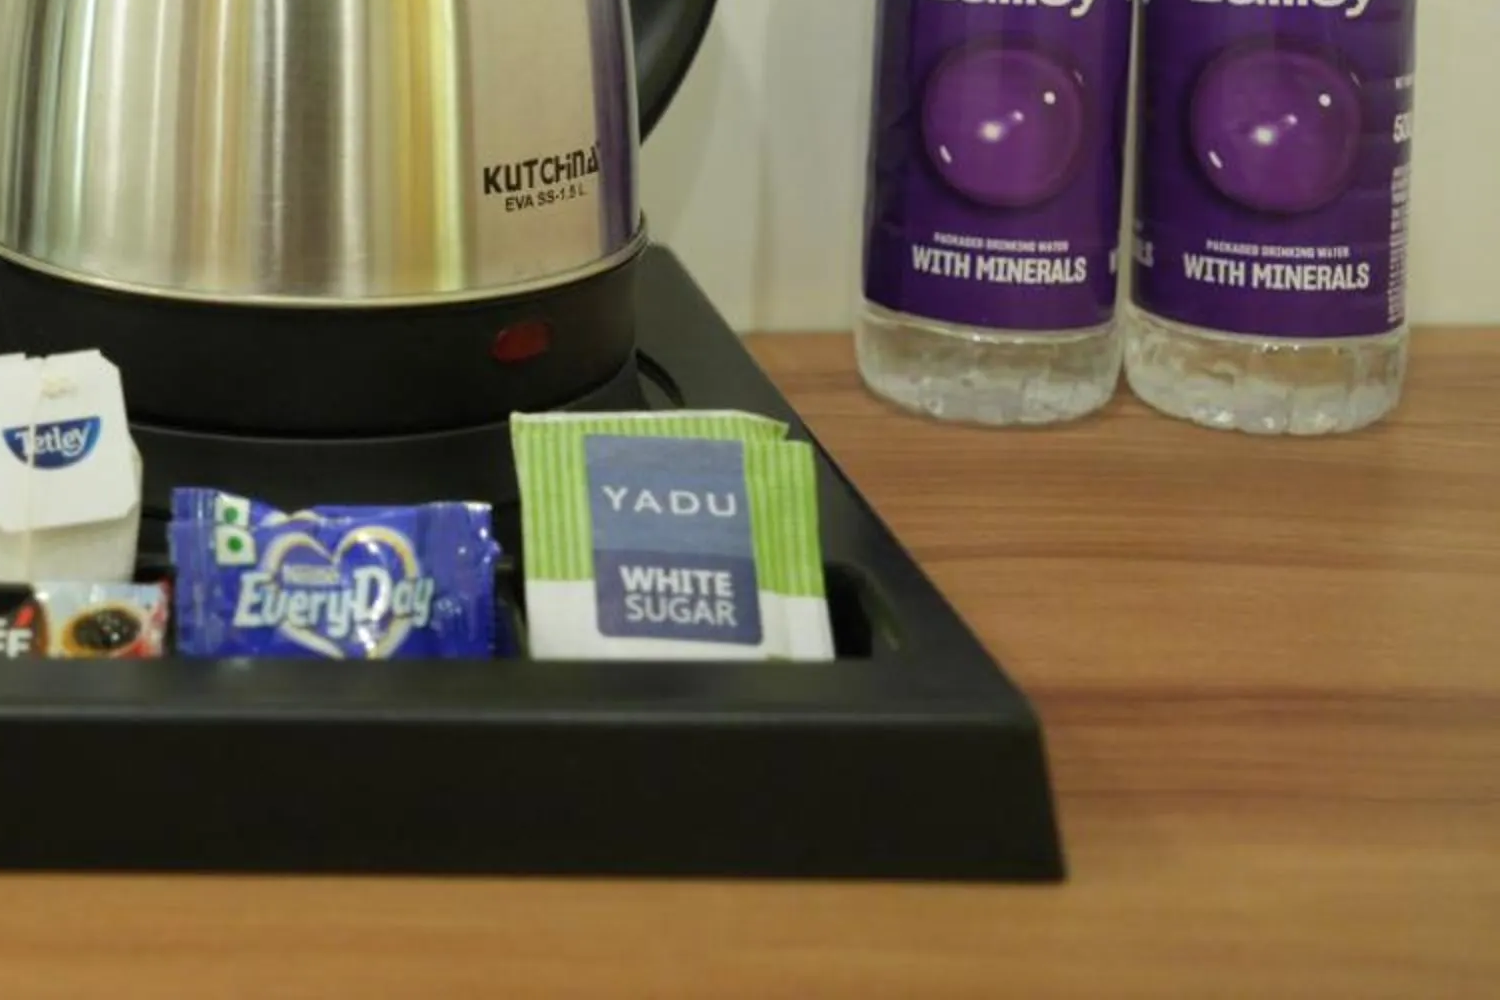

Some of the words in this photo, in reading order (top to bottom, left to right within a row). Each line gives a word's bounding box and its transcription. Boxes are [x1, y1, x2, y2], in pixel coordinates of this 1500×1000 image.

[505, 194, 534, 212] EVA
[912, 244, 971, 280] WITH
[975, 254, 1087, 285] MINERALS
[1317, 246, 1350, 259] WATER
[1183, 251, 1245, 288] WITH
[1251, 262, 1370, 291] MINERALS
[15, 422, 90, 458] Tetley
[602, 484, 737, 517] YADU
[619, 565, 734, 598] WHITE
[625, 594, 738, 627] SUGAR
